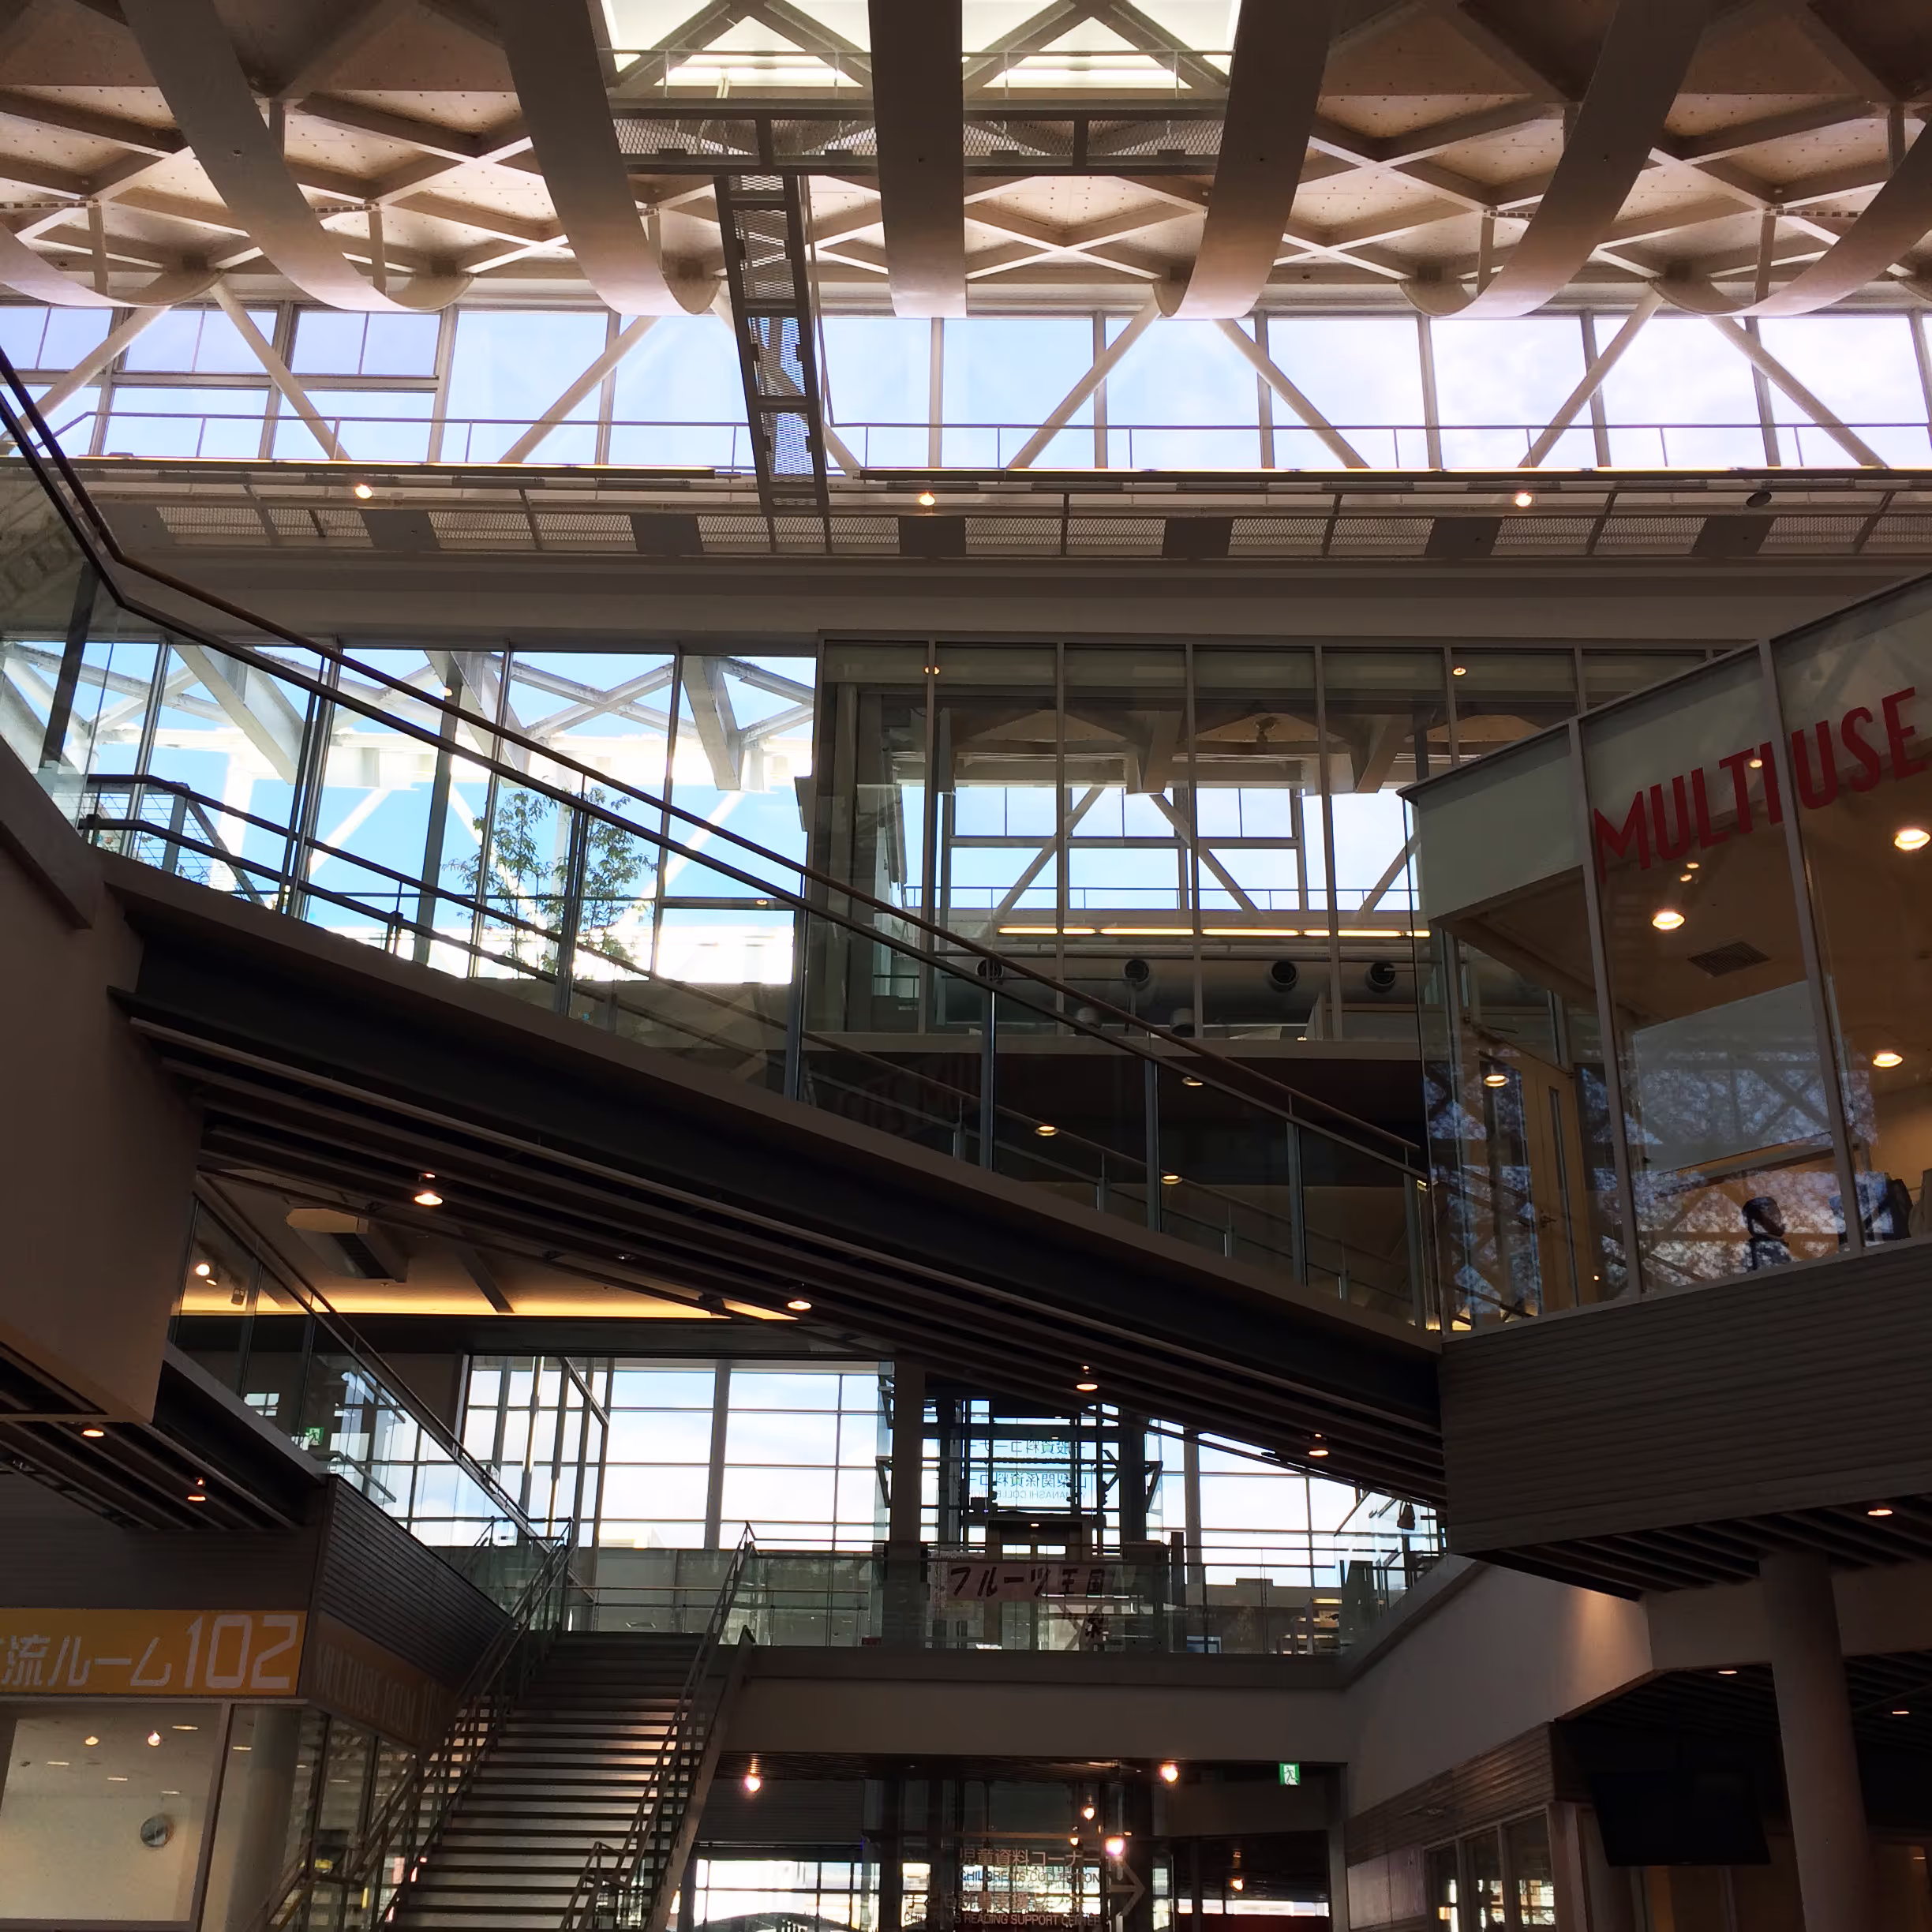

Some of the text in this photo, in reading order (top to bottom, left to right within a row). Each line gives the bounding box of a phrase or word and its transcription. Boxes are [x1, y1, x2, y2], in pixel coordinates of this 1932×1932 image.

[0, 1614, 298, 1689] 流ルーム102
[959, 1848, 1100, 1867] 児童資料コーナー
[964, 1912, 1008, 1924] READING
[1010, 1914, 1059, 1926] SUPPORT
